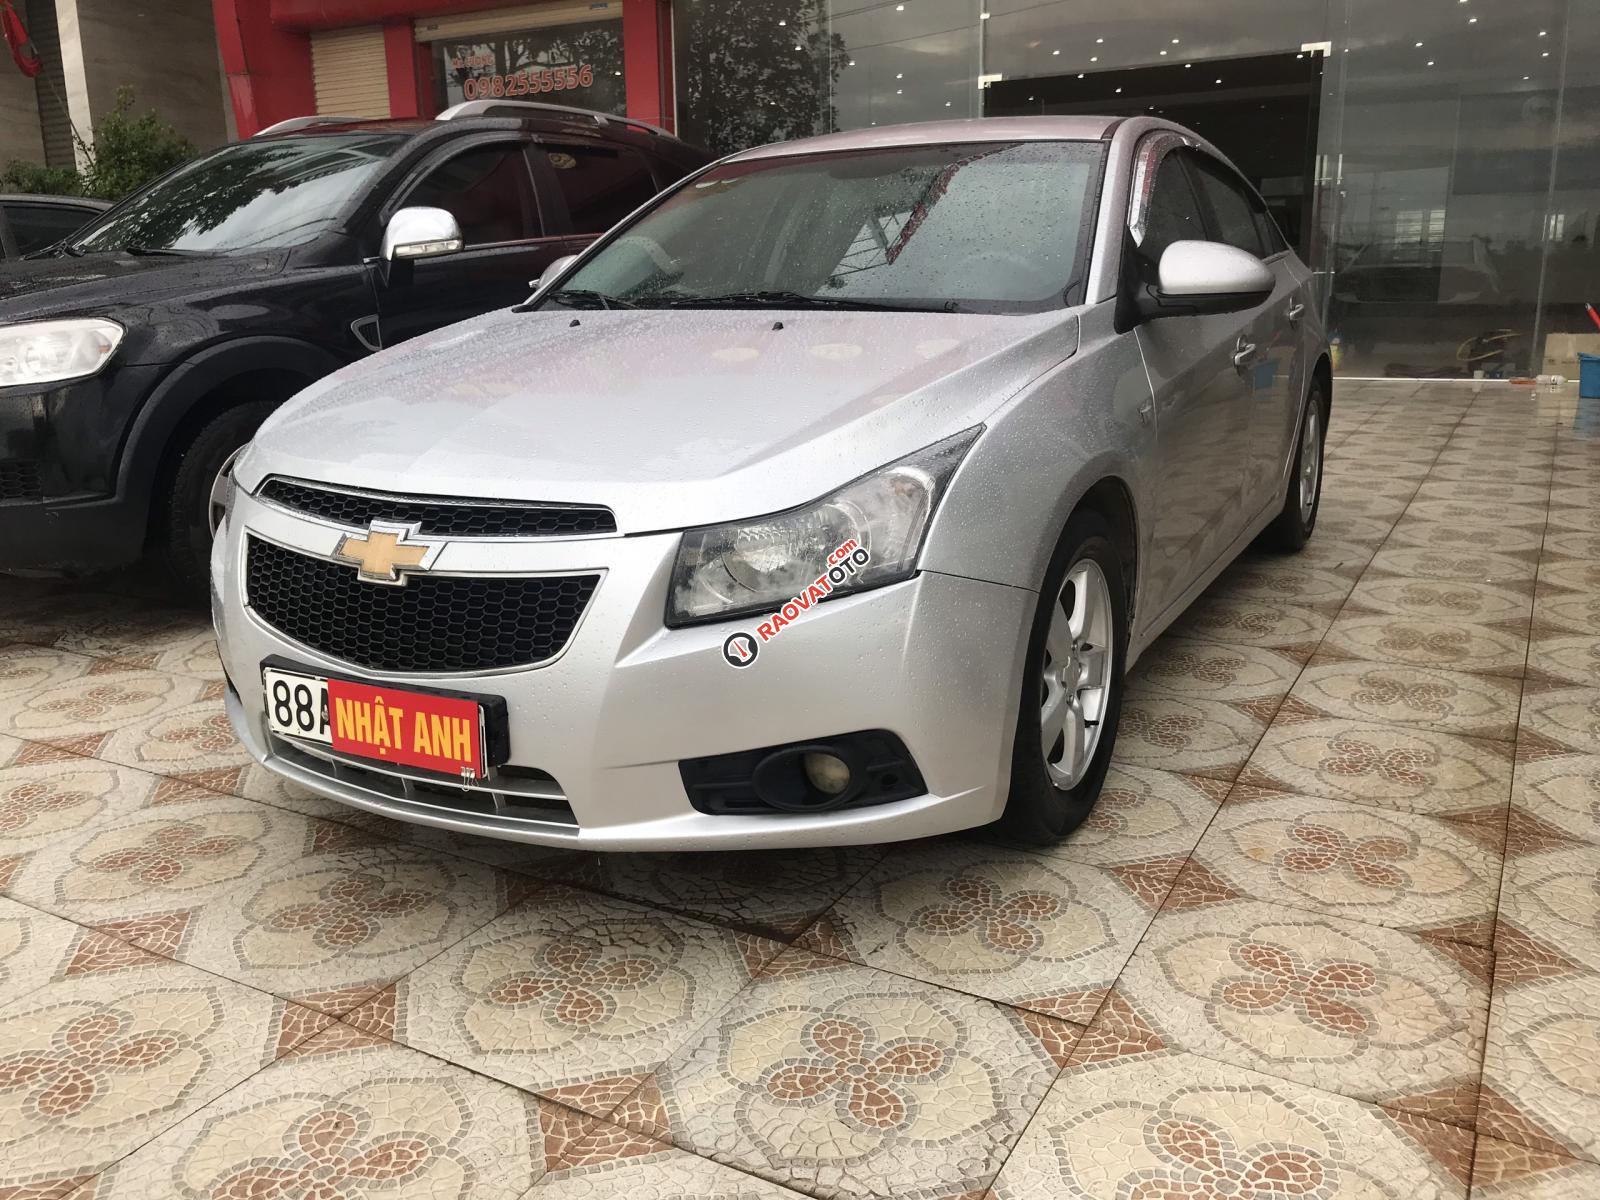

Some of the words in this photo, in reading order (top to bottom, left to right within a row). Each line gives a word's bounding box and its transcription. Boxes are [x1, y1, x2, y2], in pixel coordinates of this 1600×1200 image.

[463, 63, 594, 100] 0982555556
[335, 695, 404, 755] NHẬT
[413, 711, 472, 763] ANH
